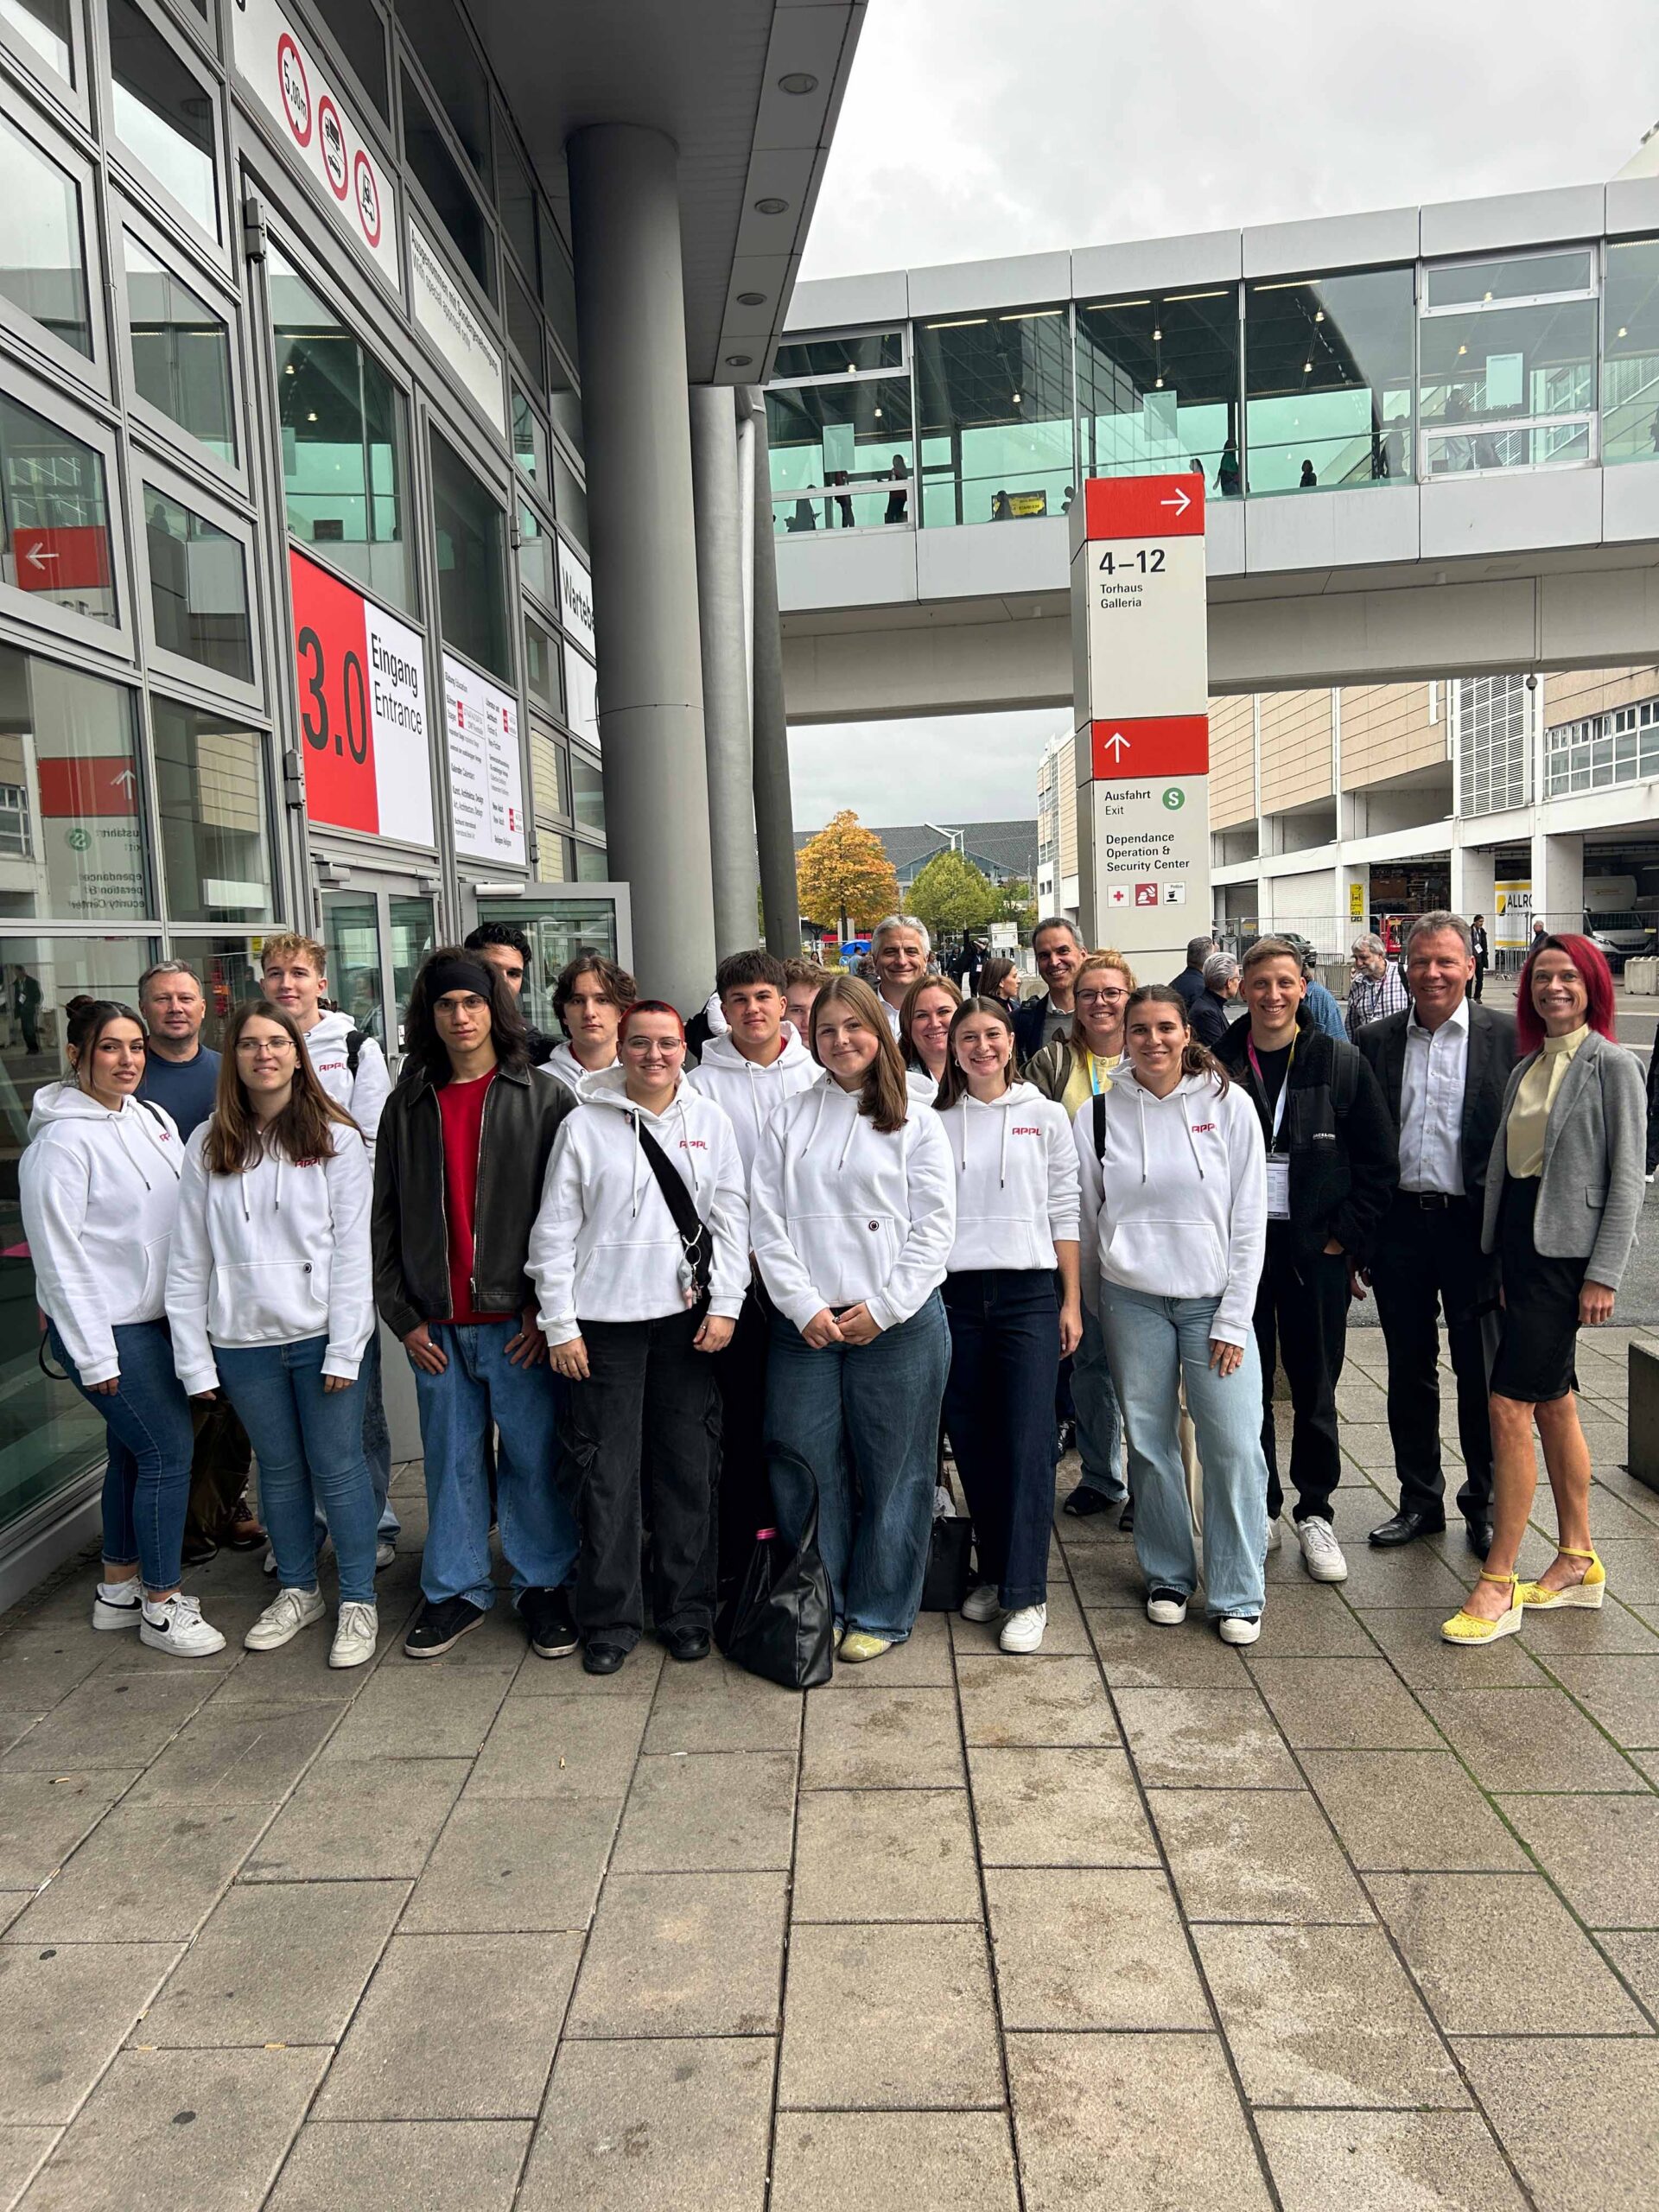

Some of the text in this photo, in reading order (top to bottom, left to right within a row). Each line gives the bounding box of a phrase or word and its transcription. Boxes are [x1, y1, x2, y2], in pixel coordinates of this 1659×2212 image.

[1100, 583, 1143, 594] Torhaus
[563, 566, 594, 632] Warteb
[1100, 597, 1141, 608] Galleria
[372, 632, 418, 698] Eingang
[298, 626, 367, 765] 3.0
[374, 681, 422, 734] Entrance
[1104, 790, 1151, 801] Ausfahrt
[1105, 805, 1124, 816] Exit
[1106, 833, 1174, 846] Dependance
[1106, 846, 1170, 859] Operation &
[1107, 860, 1190, 873] Security Center
[1012, 1127, 1042, 1136] APPL
[1192, 1122, 1217, 1133] APP
